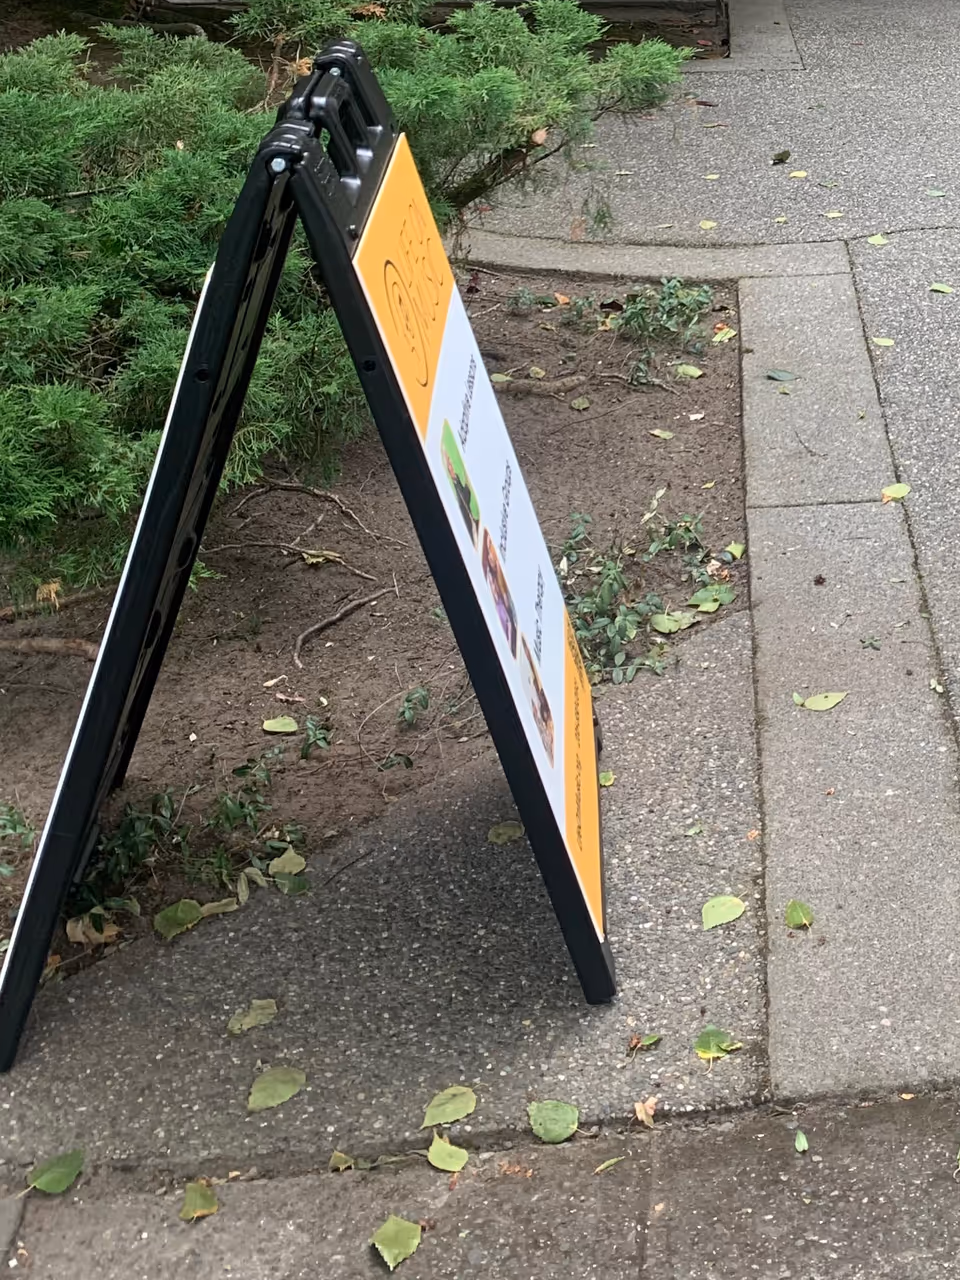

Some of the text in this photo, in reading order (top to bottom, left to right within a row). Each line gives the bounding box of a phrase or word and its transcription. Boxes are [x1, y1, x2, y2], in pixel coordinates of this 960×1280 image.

[412, 237, 444, 344] MUSIC
[457, 353, 476, 451] Adaptive Lessons
[498, 458, 512, 563] Inclusive Groups
[532, 565, 544, 666] Music Therapy
